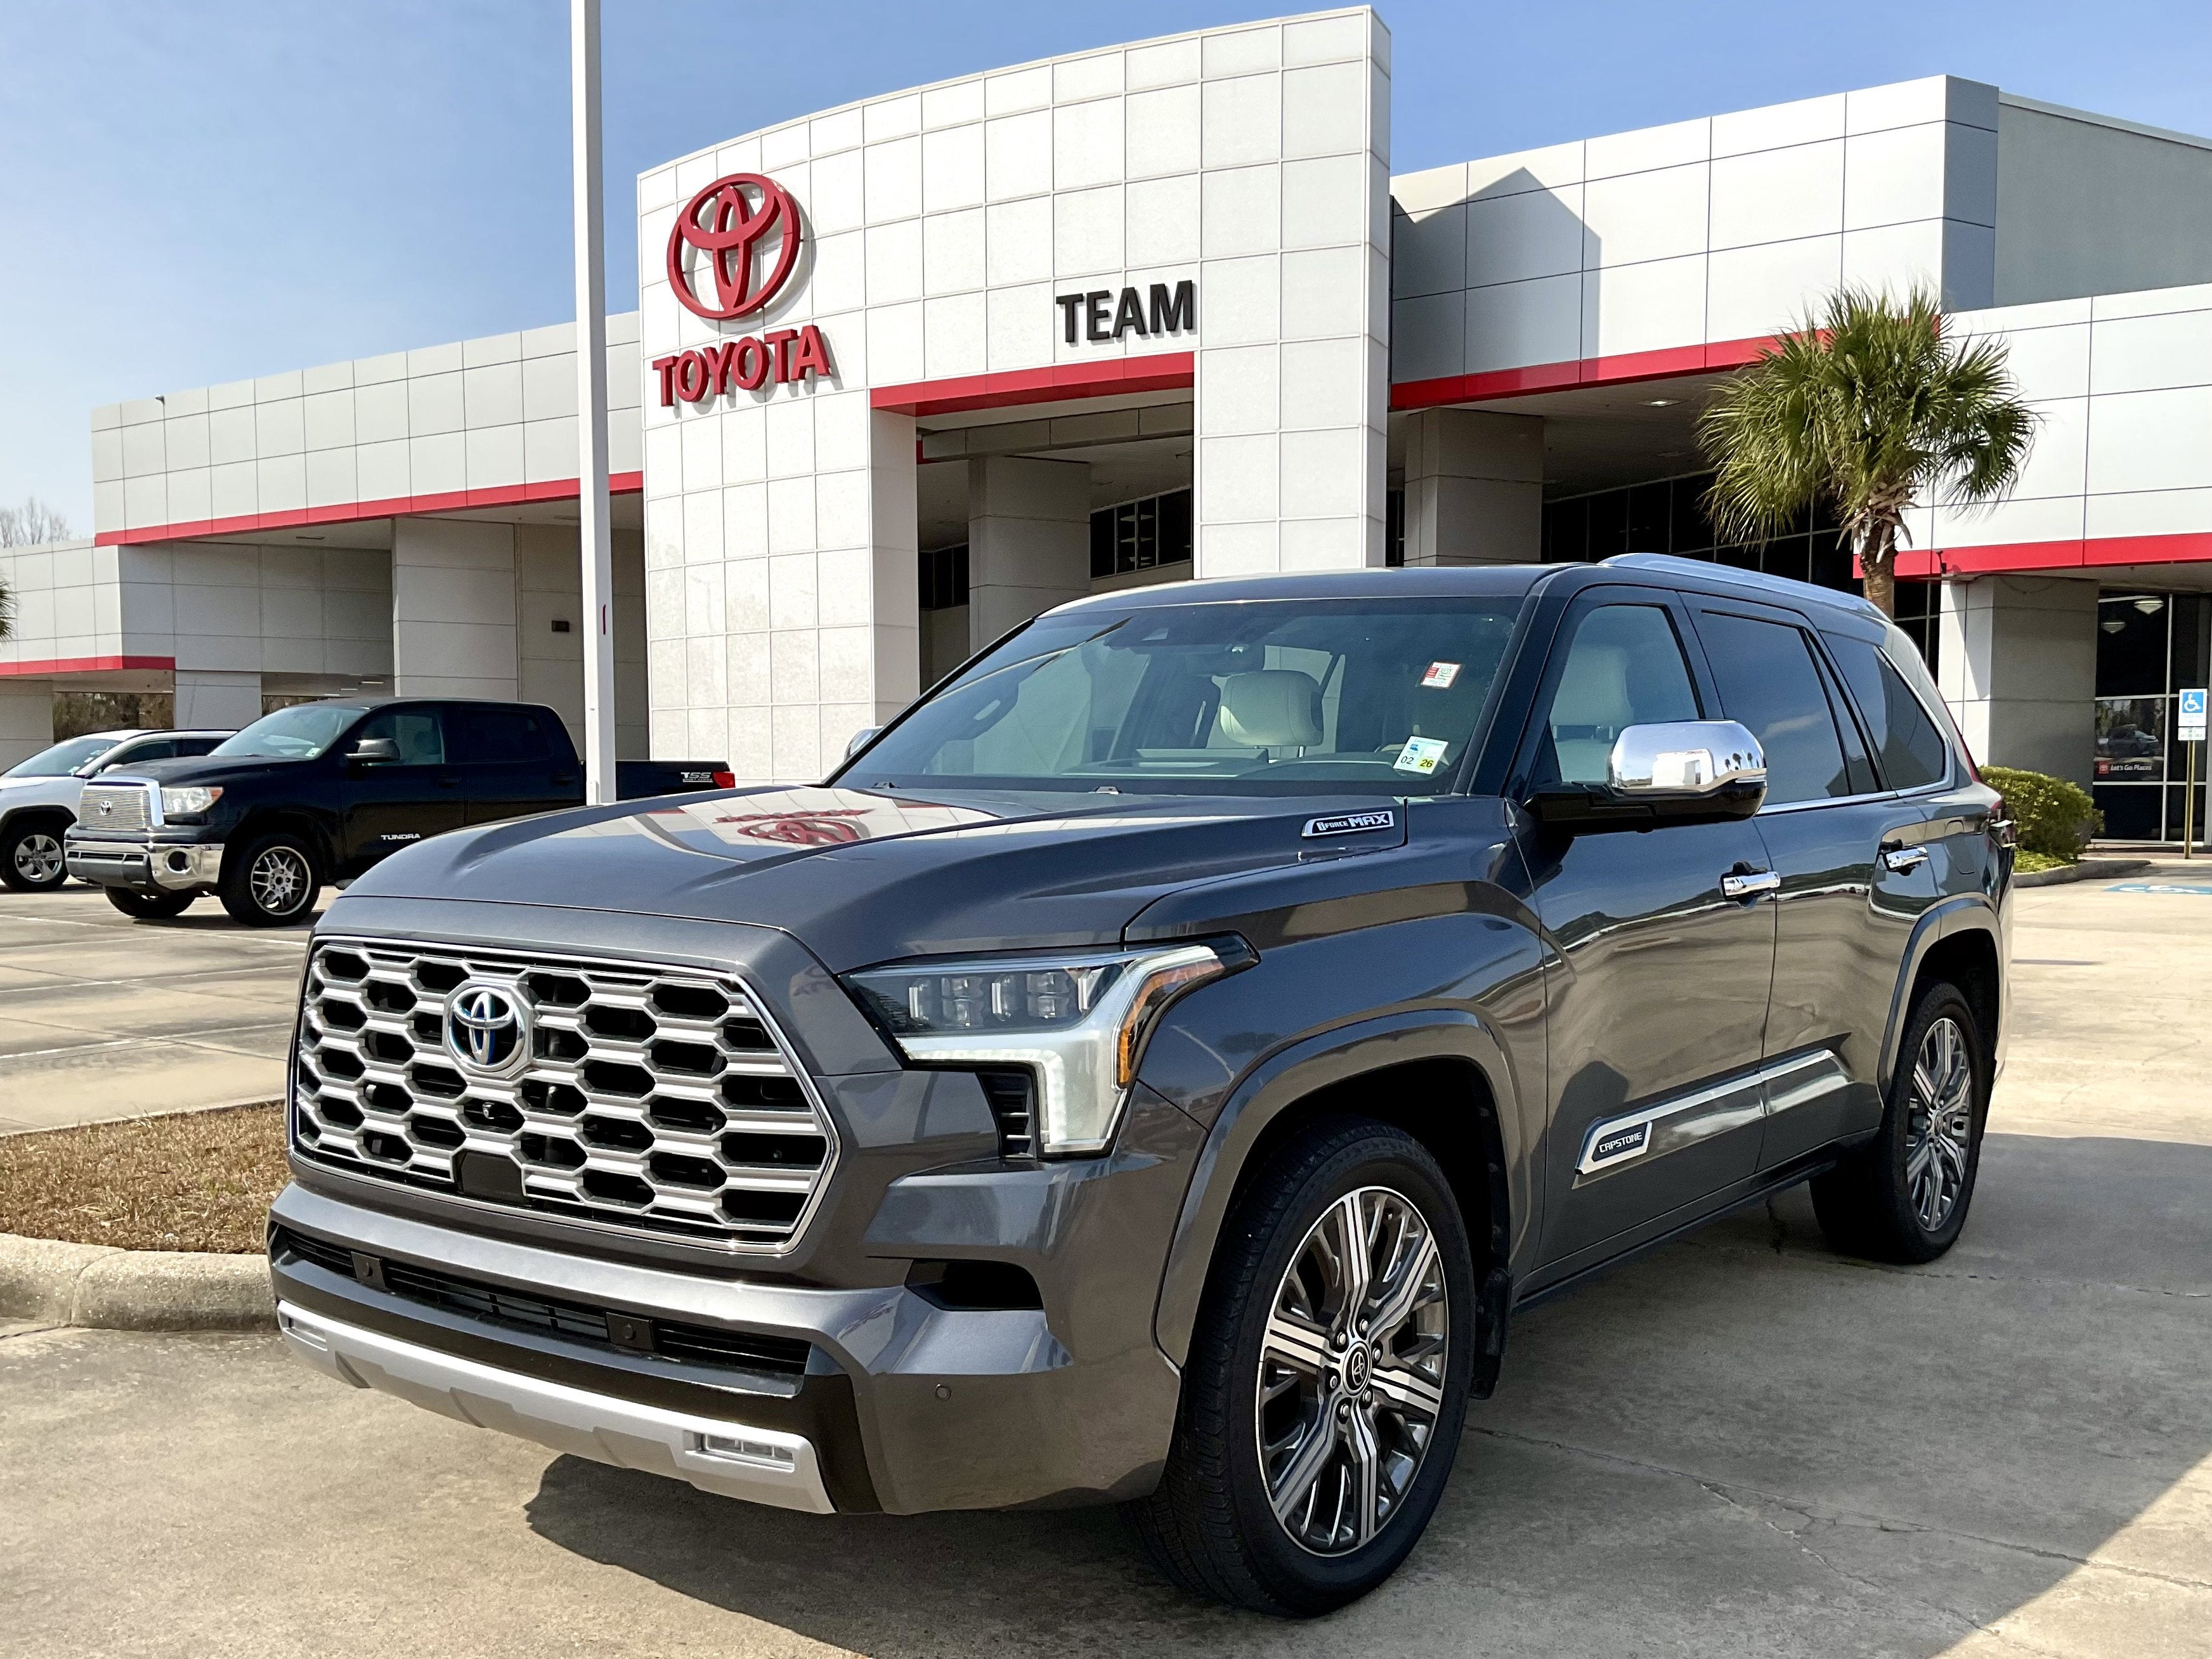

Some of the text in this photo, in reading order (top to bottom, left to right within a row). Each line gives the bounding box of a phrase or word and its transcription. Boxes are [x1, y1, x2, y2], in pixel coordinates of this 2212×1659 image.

[1056, 280, 1193, 342] TEAM
[652, 325, 831, 407] TOYOTA
[1400, 756, 1414, 765] 02
[1420, 759, 1434, 768] 26
[1348, 814, 1389, 828] MAX
[1599, 1131, 1643, 1153] CAPSTONE
